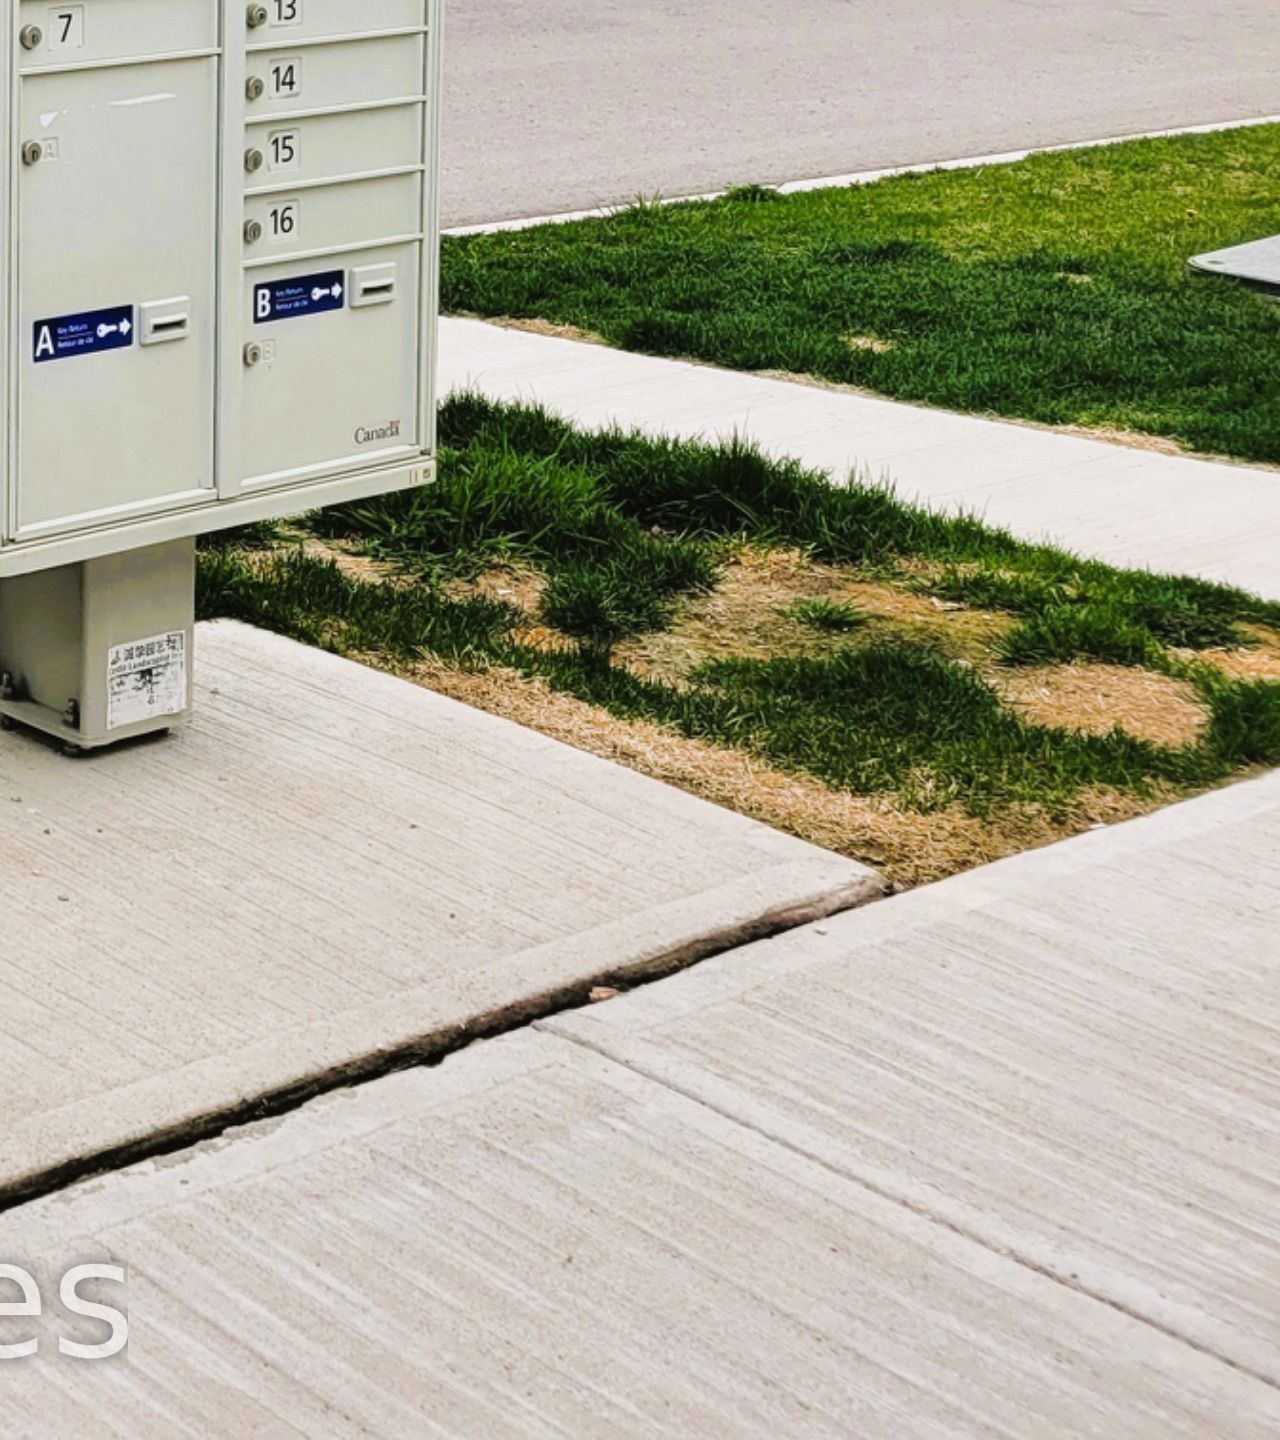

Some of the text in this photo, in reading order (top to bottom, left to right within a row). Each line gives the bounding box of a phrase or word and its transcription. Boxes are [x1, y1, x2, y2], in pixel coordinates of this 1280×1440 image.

[59, 14, 72, 42] 7
[273, 65, 295, 92] 14
[272, 136, 293, 162] 15
[271, 207, 293, 234] 16
[257, 289, 271, 318] B
[36, 325, 54, 357] A
[354, 424, 399, 445] Canada
